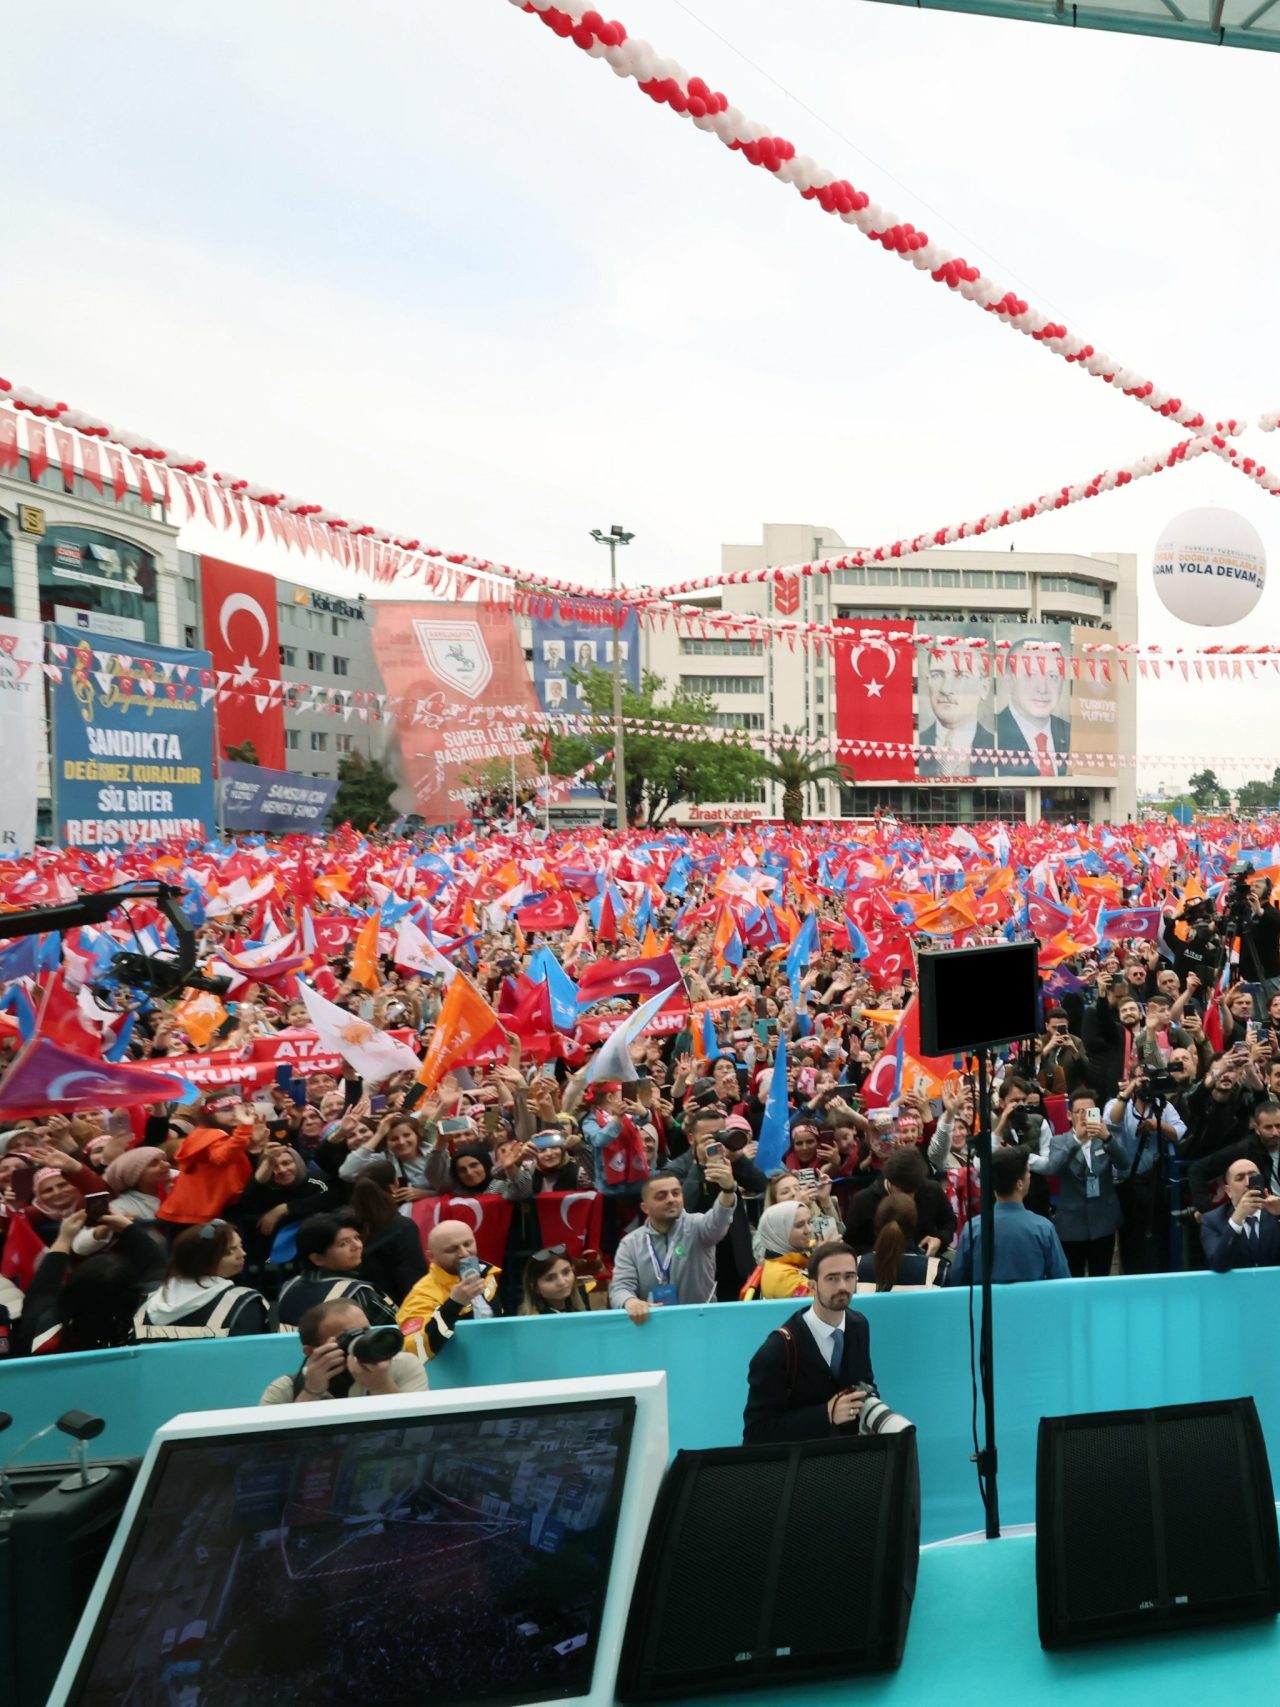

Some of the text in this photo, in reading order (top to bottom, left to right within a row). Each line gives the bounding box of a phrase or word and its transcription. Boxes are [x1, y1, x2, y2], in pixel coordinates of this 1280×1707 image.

[1179, 563, 1213, 575] YOLA
[1216, 565, 1257, 583] DEVAM
[86, 727, 182, 760] SANDIKTA
[443, 729, 487, 748] SÜPER
[434, 742, 501, 765] BAŞARILAR
[133, 764, 201, 784] KURALDIR
[127, 786, 174, 812] BİTER
[689, 807, 721, 819] Ziraat
